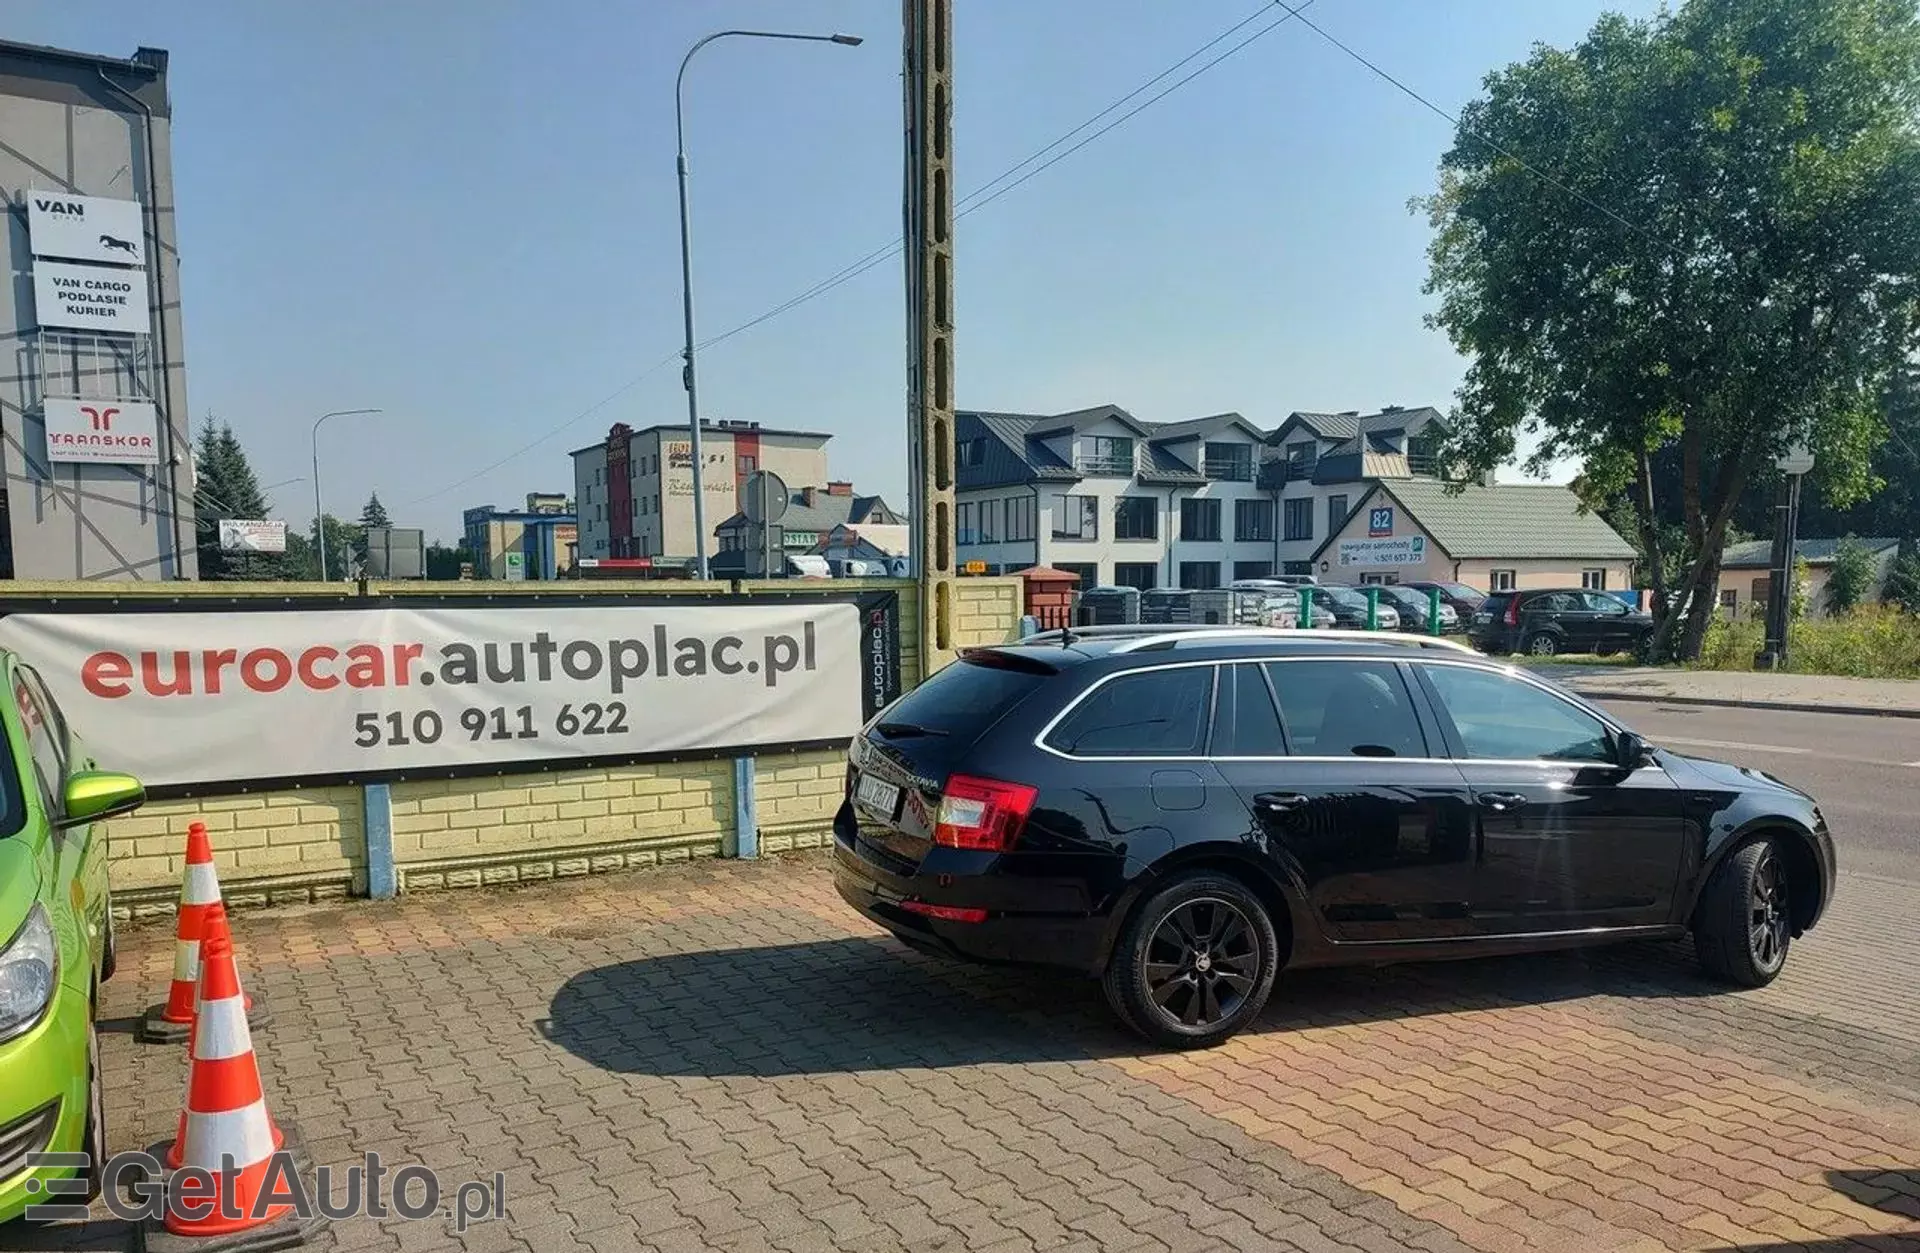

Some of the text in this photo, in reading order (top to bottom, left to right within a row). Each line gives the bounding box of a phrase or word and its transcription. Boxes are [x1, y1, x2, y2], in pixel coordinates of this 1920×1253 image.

[35, 199, 84, 216] VAN
[53, 277, 131, 292] VAN CARGO
[58, 291, 127, 305] PODLASIE
[66, 305, 116, 317] KURIER
[49, 433, 152, 448] TRANSKOR
[1373, 511, 1390, 528] 82
[81, 621, 816, 698] eurocar.autoplac.pl
[870, 608, 884, 708] autoplac.pl
[355, 701, 630, 748] 510 911 622
[906, 774, 939, 790] OCTAVIA
